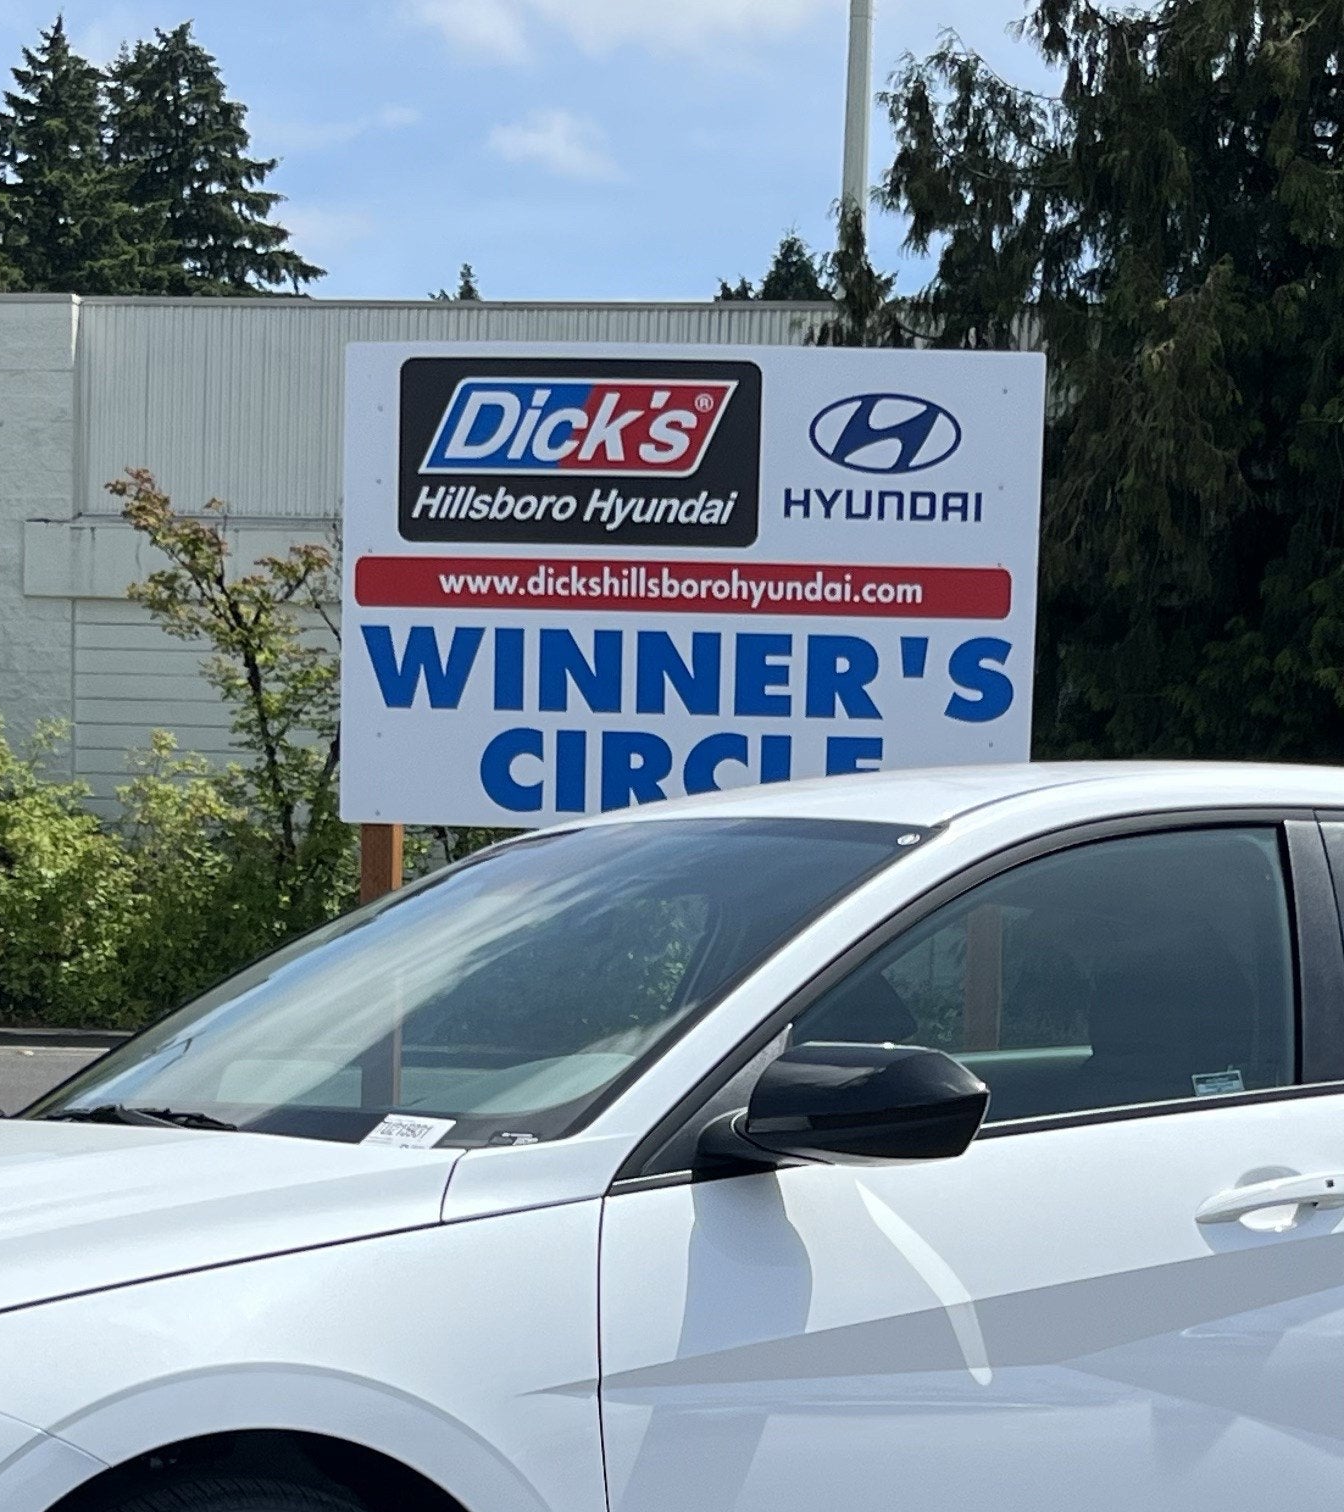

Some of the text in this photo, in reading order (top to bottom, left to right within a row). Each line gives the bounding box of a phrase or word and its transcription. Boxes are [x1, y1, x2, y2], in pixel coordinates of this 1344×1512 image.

[445, 389, 698, 463] Dick's
[411, 486, 738, 531] Hillsboro Hyundai
[783, 487, 983, 523] HYUNDAI
[439, 567, 923, 608] www.dickshillsborohyundai.com
[361, 625, 1015, 723] WINNER'S
